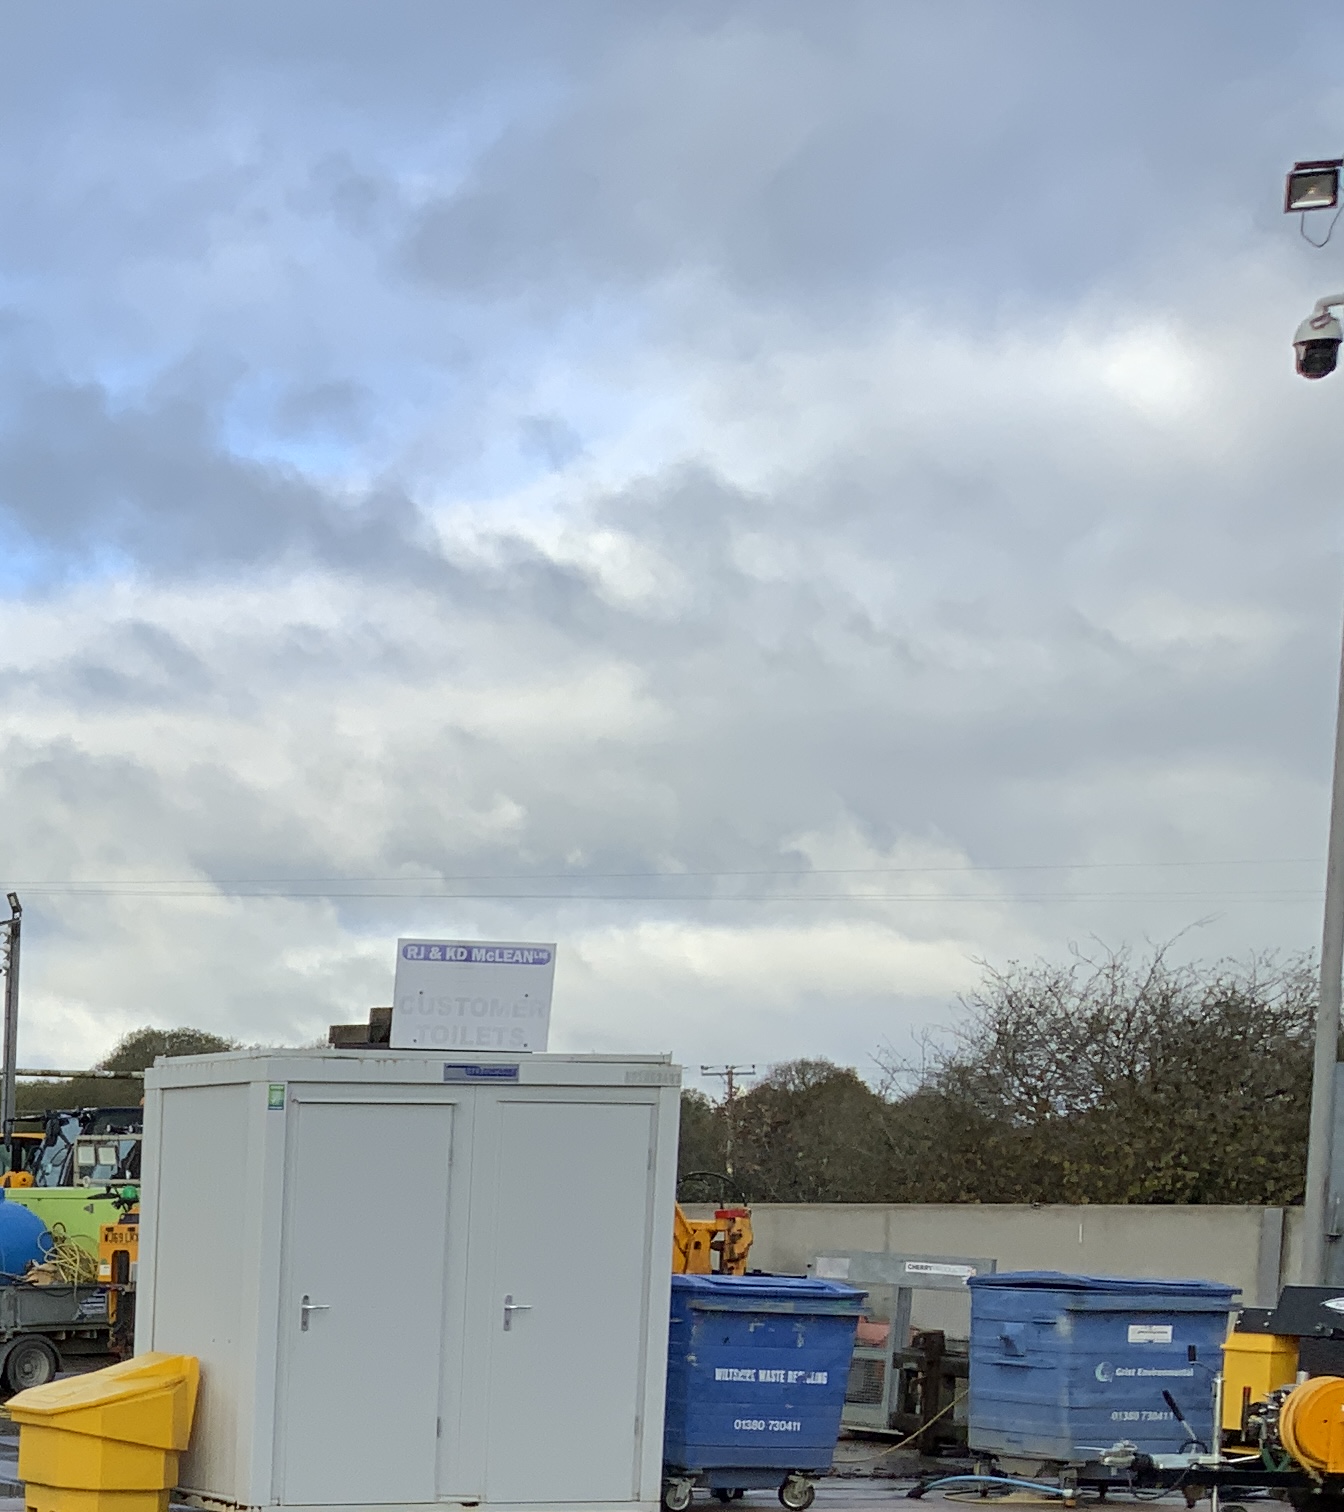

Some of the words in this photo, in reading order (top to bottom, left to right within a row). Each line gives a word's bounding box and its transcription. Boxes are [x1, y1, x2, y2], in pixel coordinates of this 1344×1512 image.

[406, 946, 425, 960] RJ
[428, 946, 442, 960] &
[445, 947, 468, 960] KD
[471, 948, 534, 963] McLEAN
[399, 996, 546, 1018] CUSTOMER
[416, 1023, 526, 1046] TOILETS
[759, 1369, 786, 1383] WASTE
[733, 1419, 765, 1430] 01380
